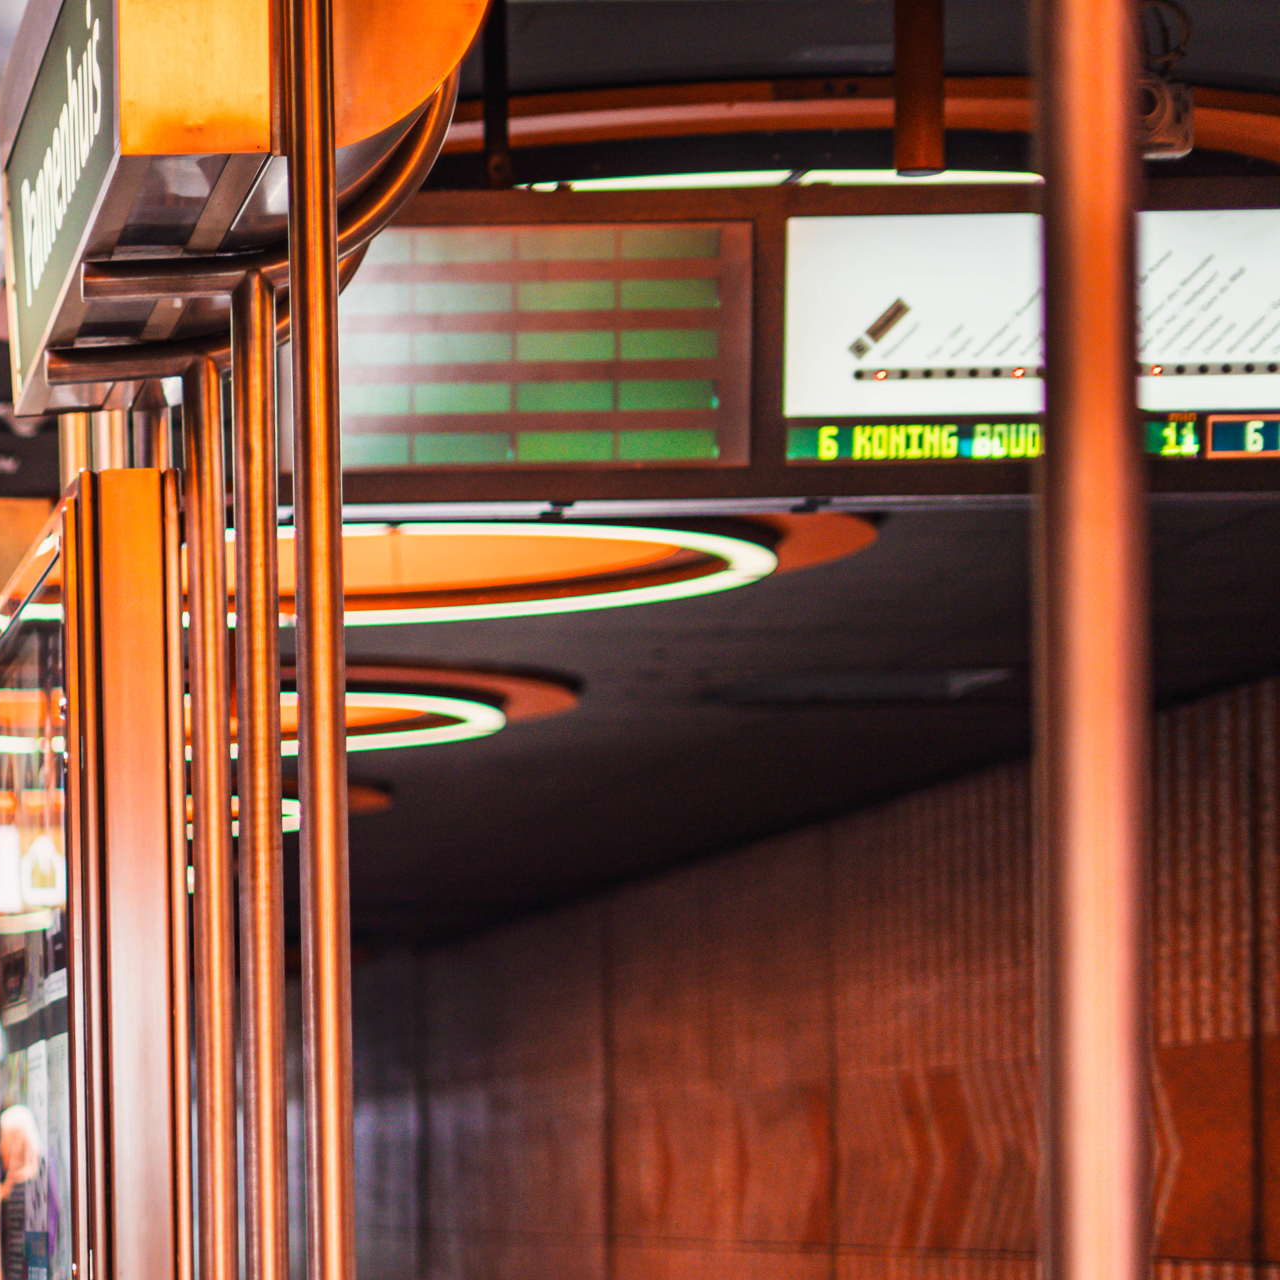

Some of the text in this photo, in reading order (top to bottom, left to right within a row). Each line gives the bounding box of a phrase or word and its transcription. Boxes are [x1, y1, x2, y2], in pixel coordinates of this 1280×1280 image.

[21, 0, 101, 306] Pannenhuis
[817, 421, 1200, 461] 6 KONING BOUD 11
[1245, 420, 1265, 453] 6
